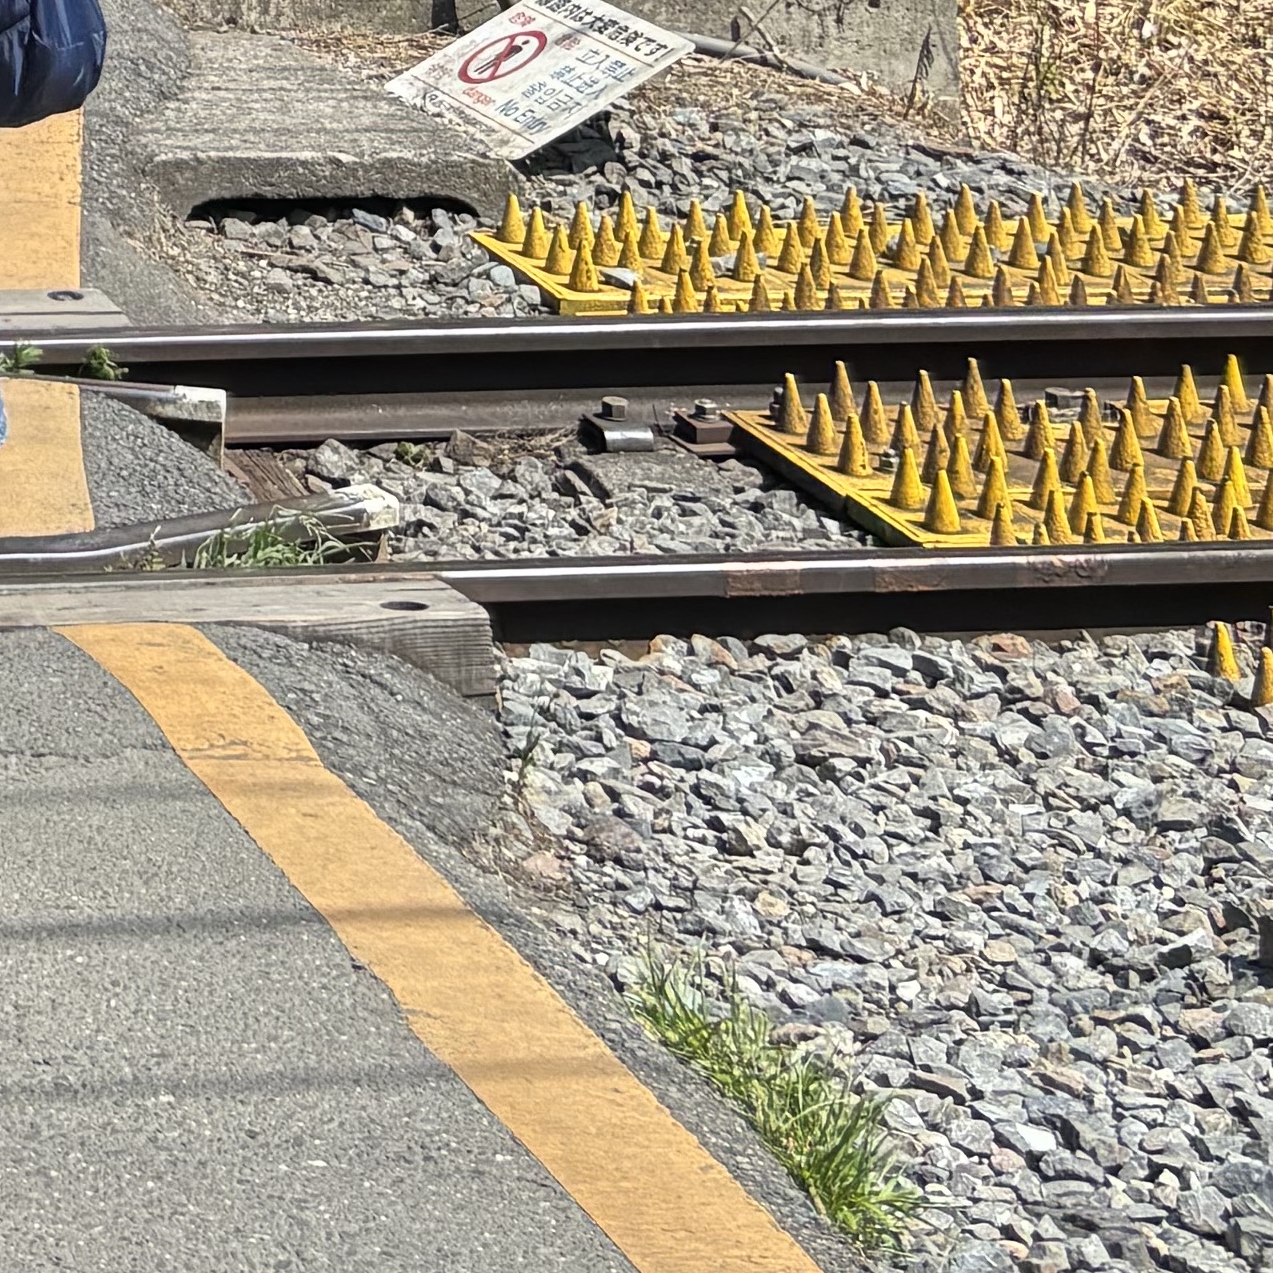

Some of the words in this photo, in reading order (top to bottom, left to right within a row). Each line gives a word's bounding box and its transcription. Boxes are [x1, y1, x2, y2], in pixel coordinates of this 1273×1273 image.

[575, 49, 636, 83] 立入禁止
[494, 98, 520, 117] No
[513, 108, 551, 136] Entry
